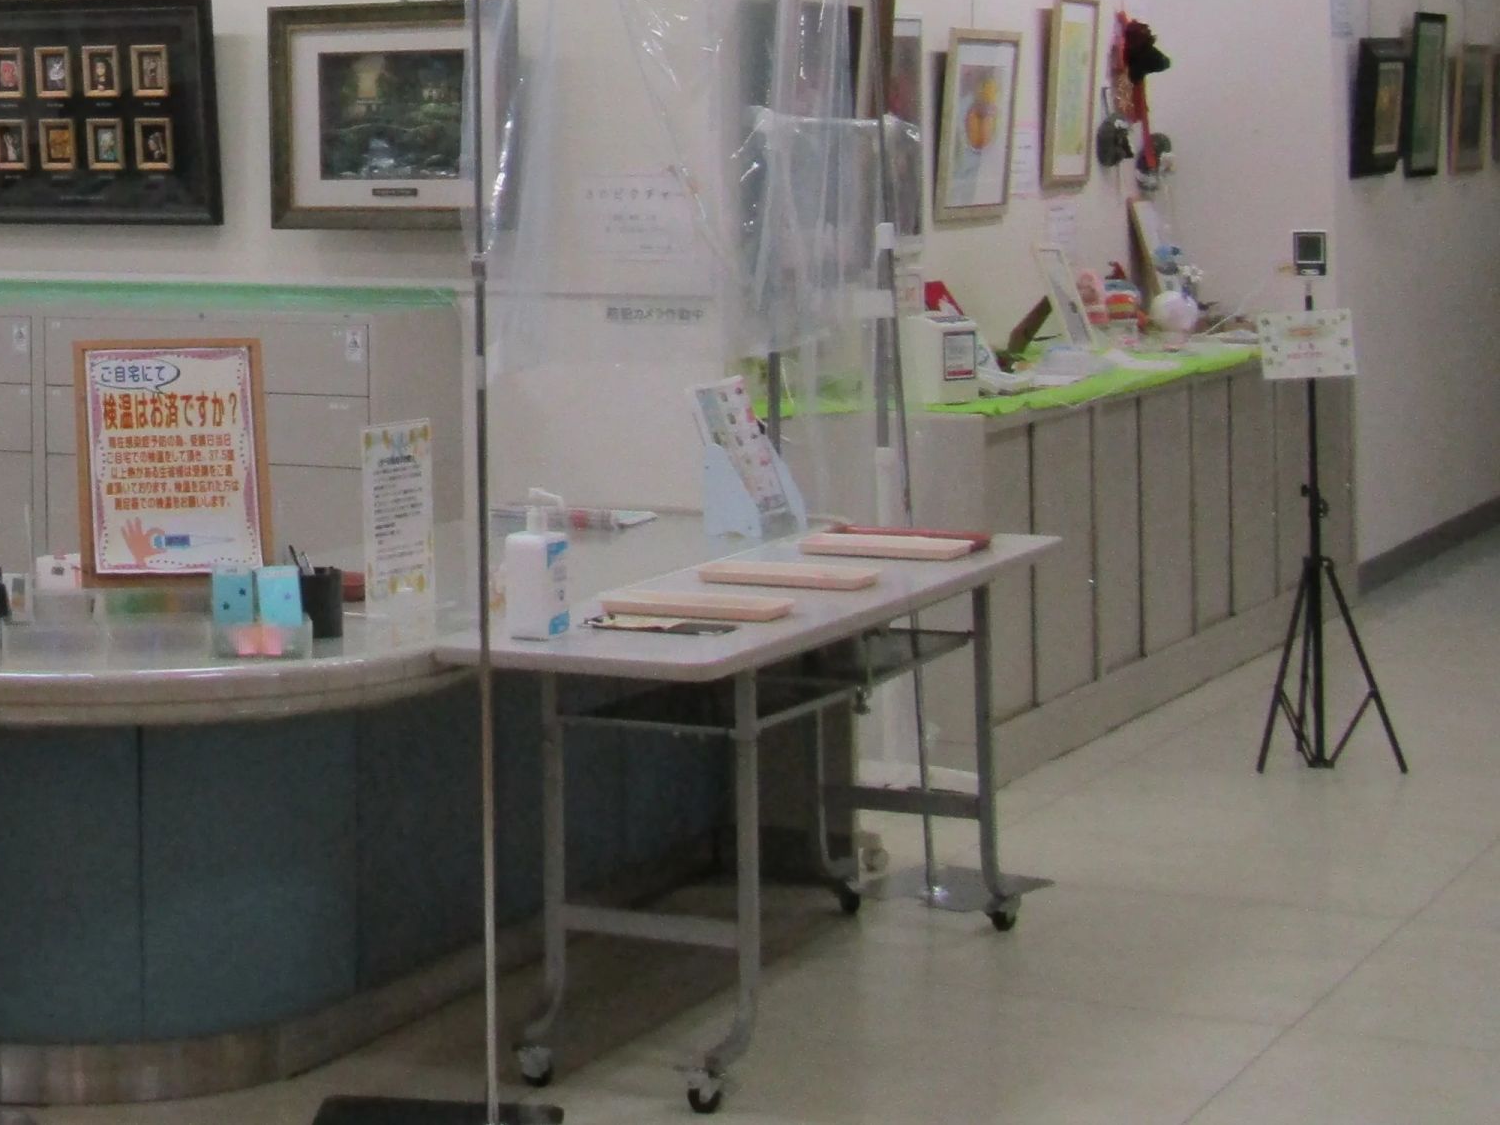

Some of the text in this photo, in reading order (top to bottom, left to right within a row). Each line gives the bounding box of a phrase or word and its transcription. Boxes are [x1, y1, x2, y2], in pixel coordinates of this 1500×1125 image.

[101, 365, 166, 383] ご自宅にて
